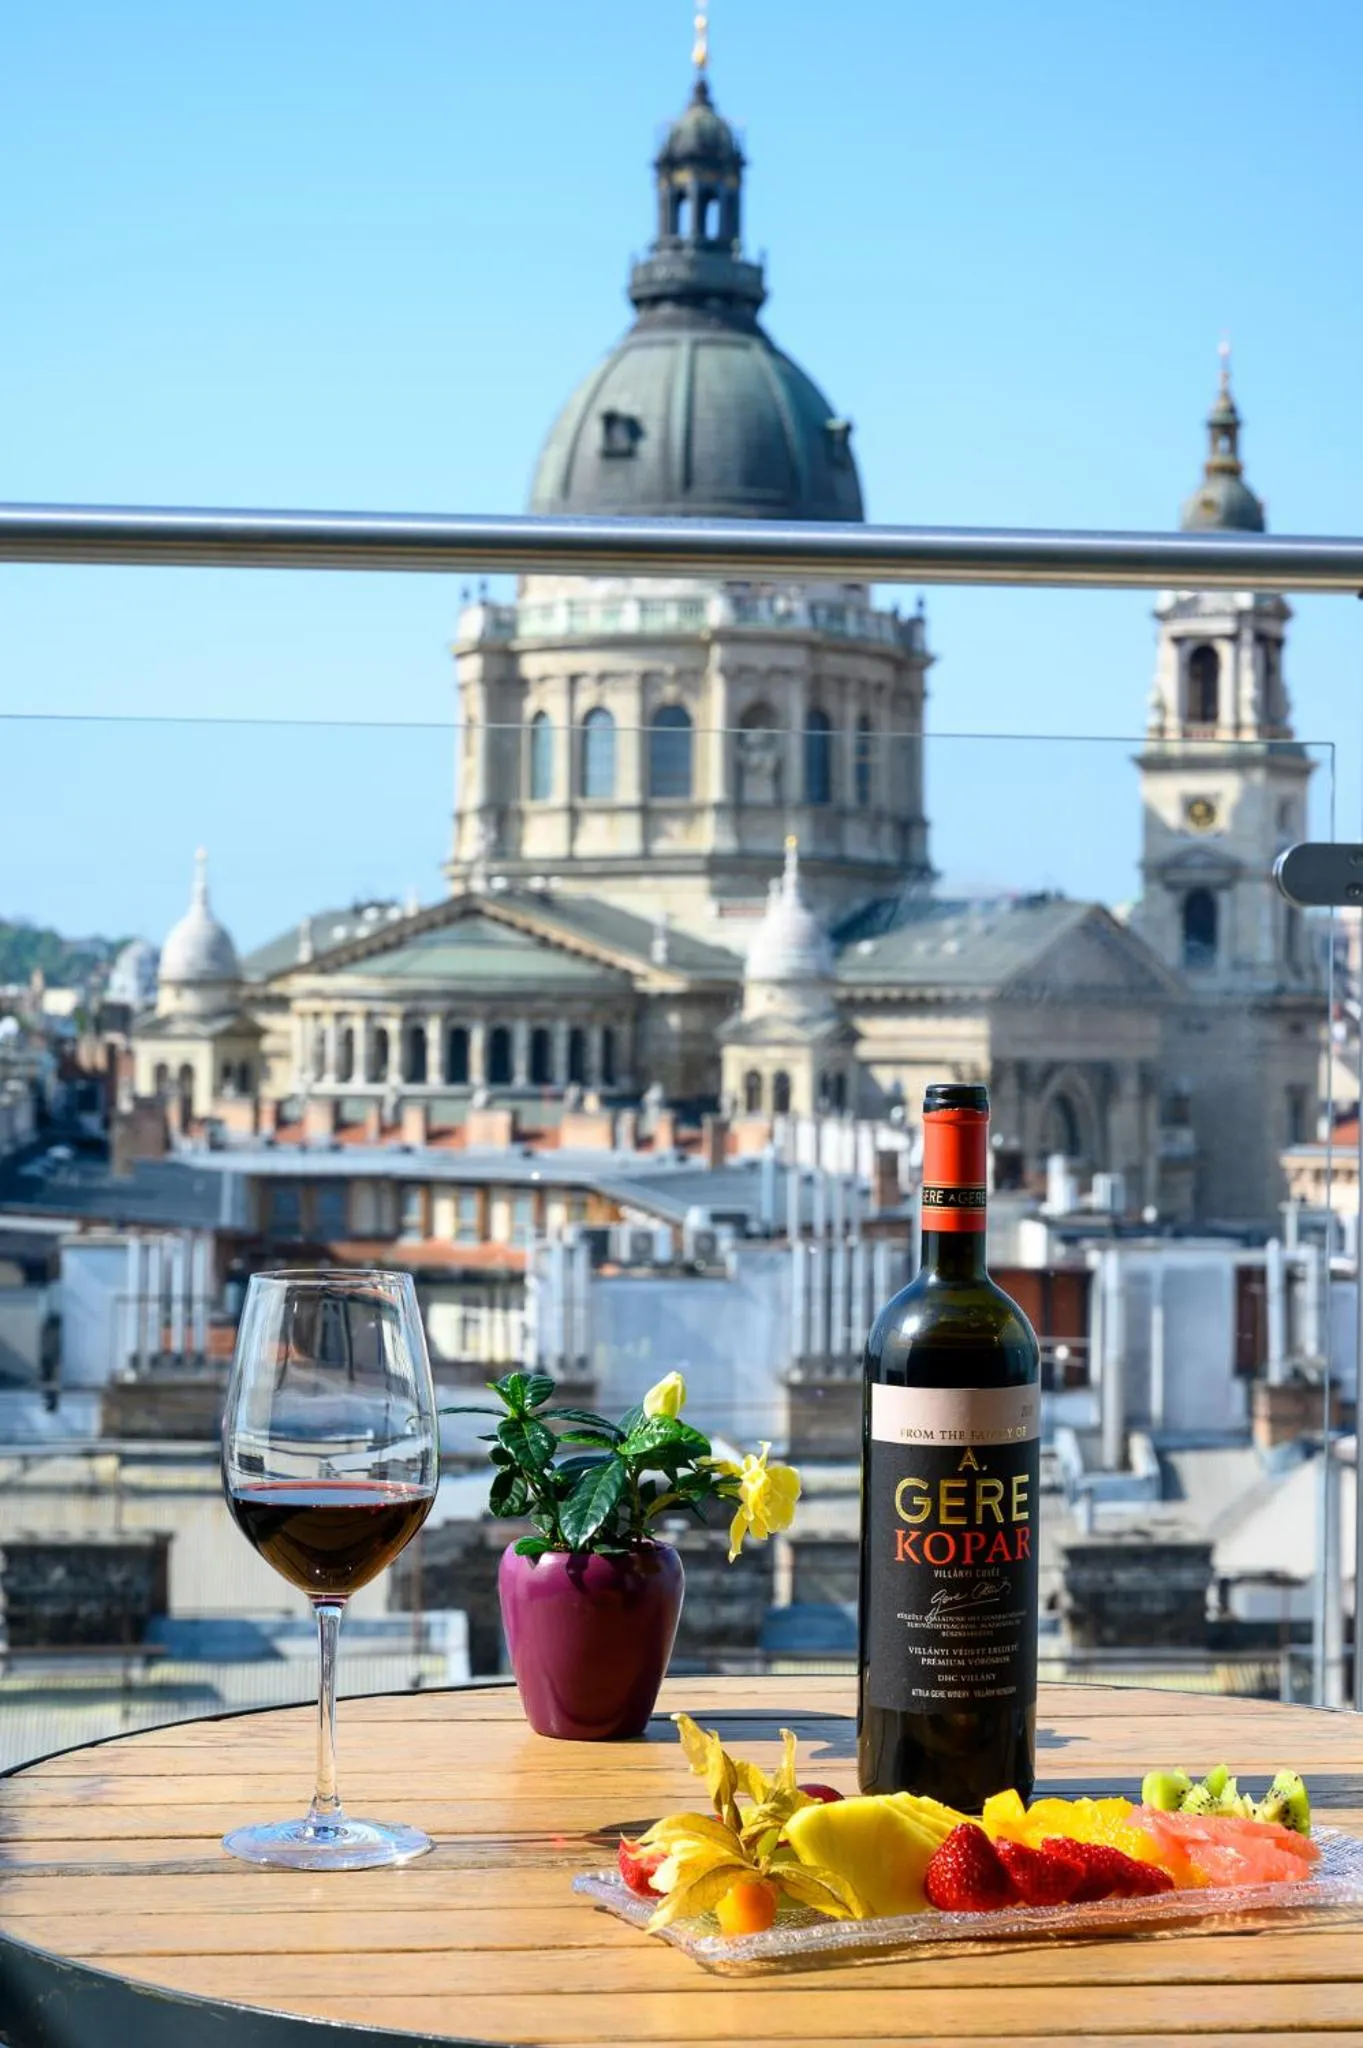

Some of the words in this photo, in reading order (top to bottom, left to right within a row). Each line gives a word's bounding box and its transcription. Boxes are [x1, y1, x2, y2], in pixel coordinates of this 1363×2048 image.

[900, 1428, 935, 1441] FROM
[939, 1430, 965, 1441] THE
[957, 1446, 988, 1472] A.
[895, 1474, 1030, 1525] GERE
[894, 1526, 1032, 1565] KOPAR
